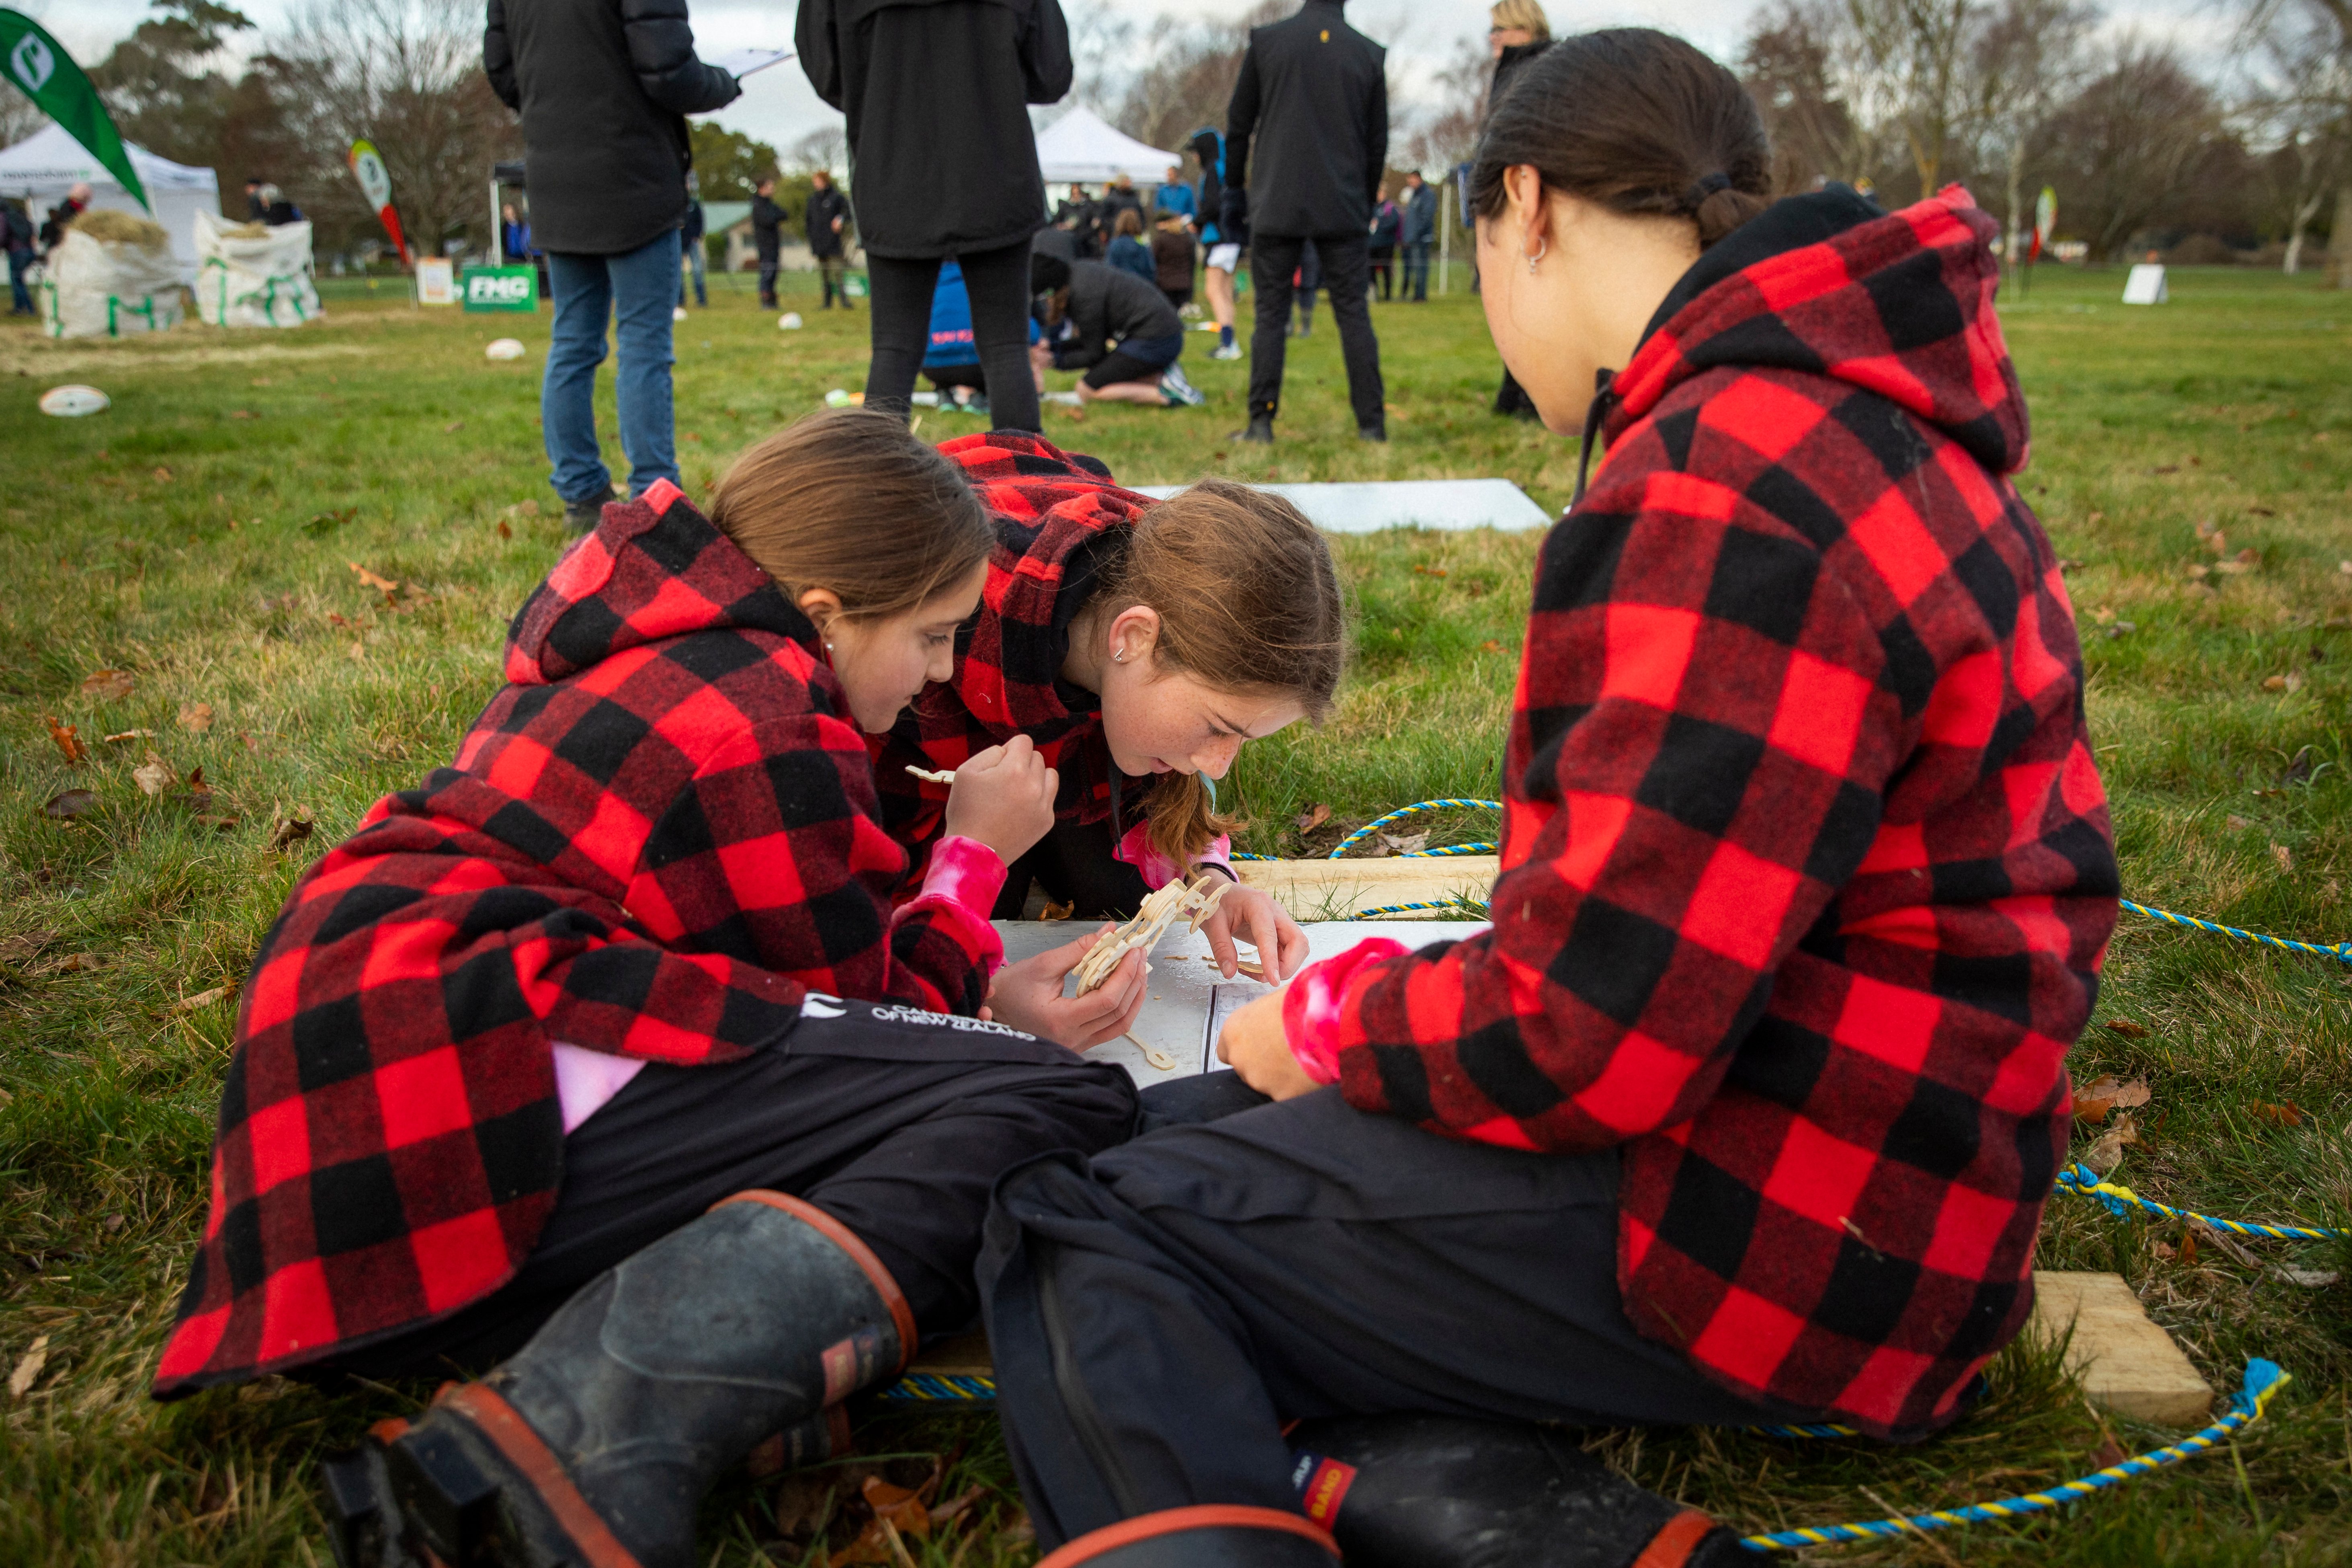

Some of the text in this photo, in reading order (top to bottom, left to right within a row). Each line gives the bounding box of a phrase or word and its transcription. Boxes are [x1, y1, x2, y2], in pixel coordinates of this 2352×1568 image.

[469, 276, 530, 299] FMG
[871, 1007, 899, 1022] OF
[901, 1013, 948, 1026] NEW
[951, 1020, 1037, 1042] ZEALAND
[1310, 1468, 1343, 1520] BAND
